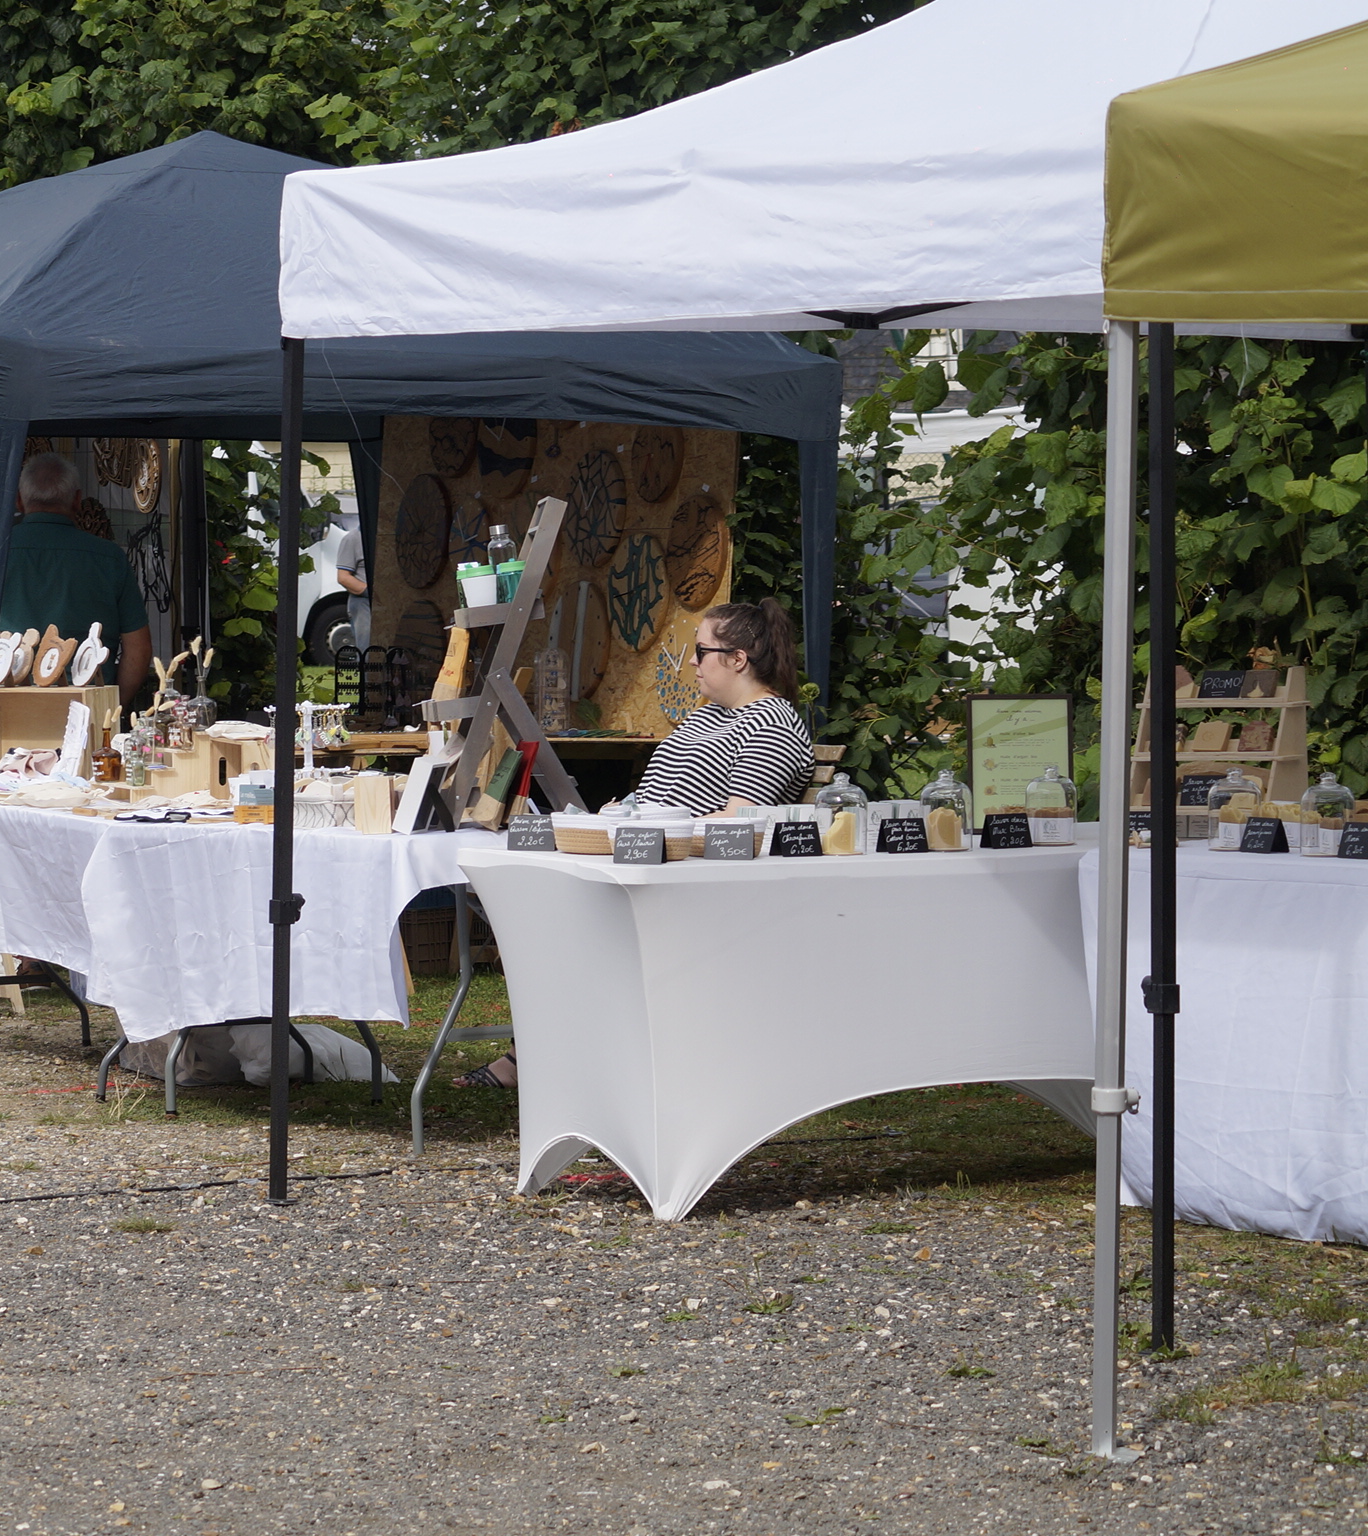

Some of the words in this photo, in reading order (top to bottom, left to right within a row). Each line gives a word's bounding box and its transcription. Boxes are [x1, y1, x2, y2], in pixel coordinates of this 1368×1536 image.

[1203, 674, 1244, 690] PROMO!
[510, 816, 529, 825] Savon
[989, 815, 1010, 825] Savon
[706, 826, 728, 837] Savon
[729, 828, 750, 838] enfant
[779, 823, 796, 834] Savon
[616, 829, 636, 840] Savon
[638, 831, 659, 840] enfant
[517, 835, 545, 847] 2,20€
[896, 841, 919, 852] 6,20€
[999, 836, 1025, 847] 6,20€
[623, 849, 649, 860] 2,90€
[719, 847, 748, 858] 3,50€
[790, 844, 815, 855] 6,20€
